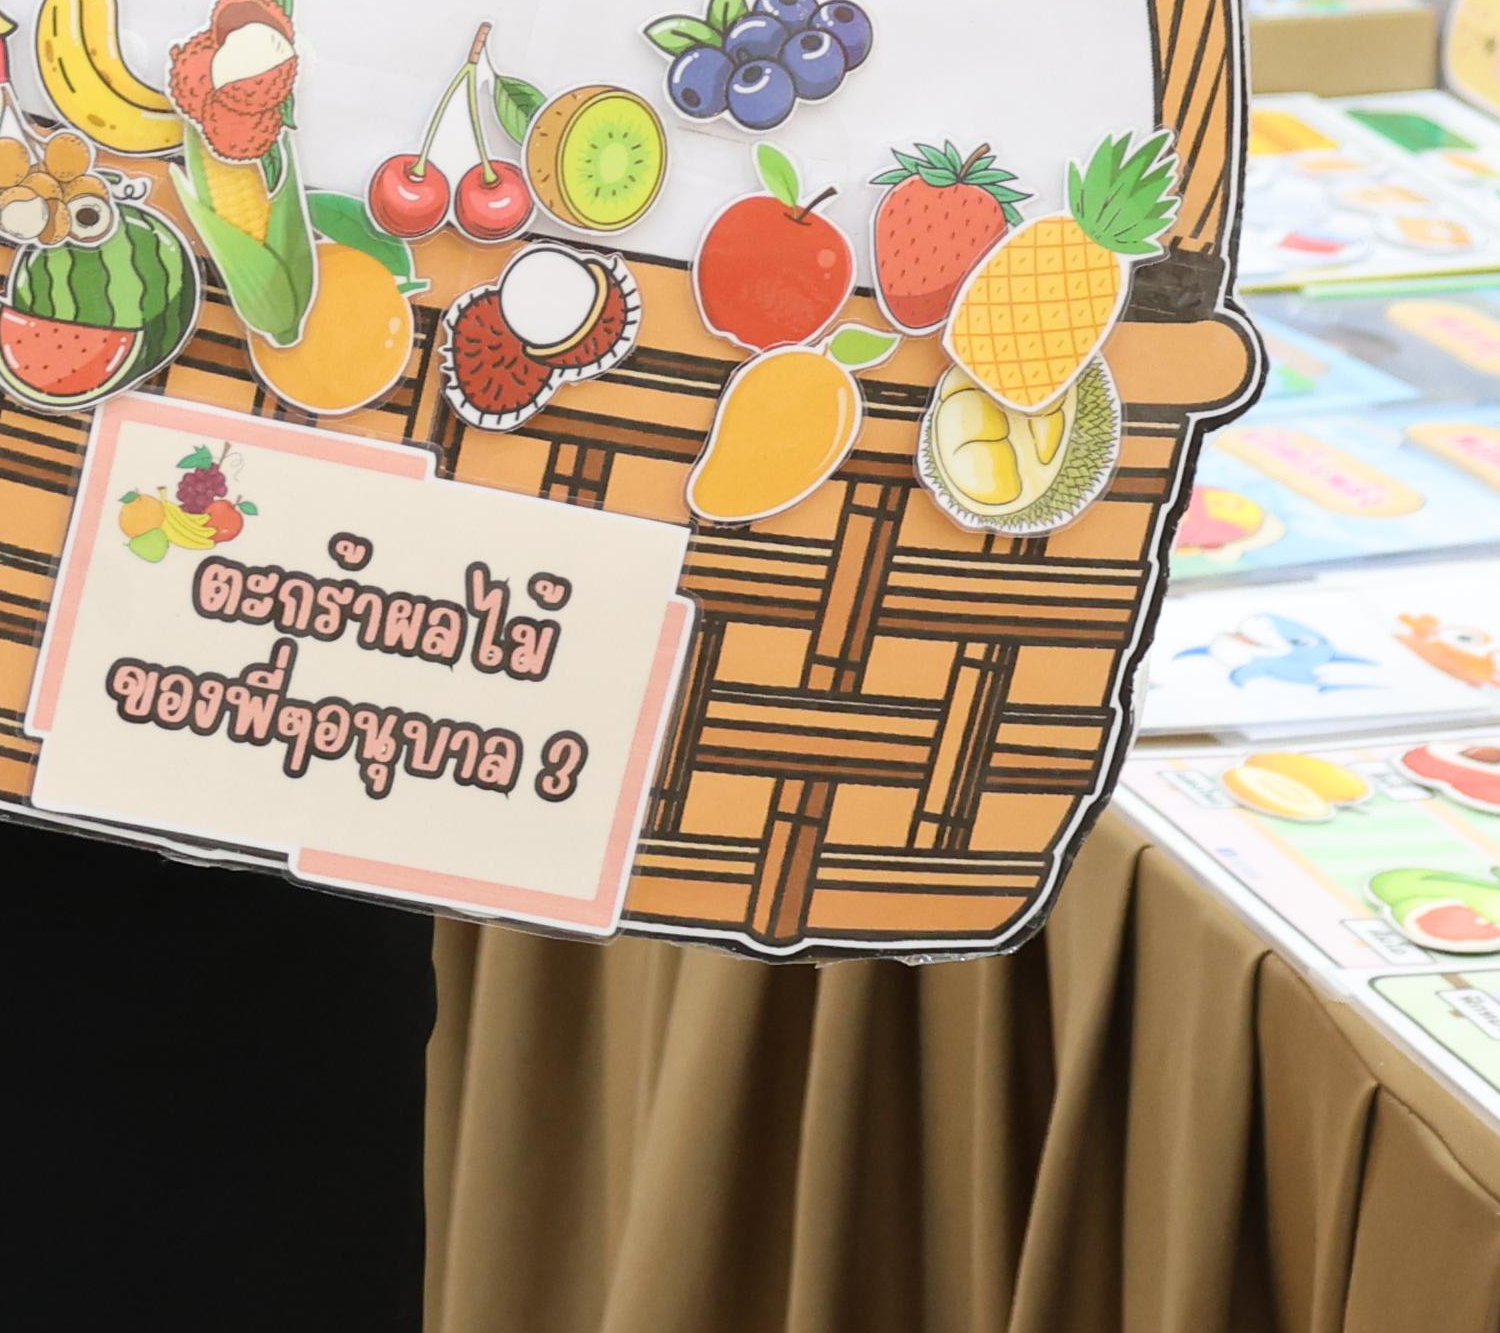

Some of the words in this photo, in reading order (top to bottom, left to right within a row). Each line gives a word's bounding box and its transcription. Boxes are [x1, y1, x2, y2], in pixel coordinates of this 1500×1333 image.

[192, 531, 574, 683] ตะกร้าผลไม้
[106, 636, 524, 801] ของพี่ๆอนุบาล
[533, 729, 590, 803] 3
